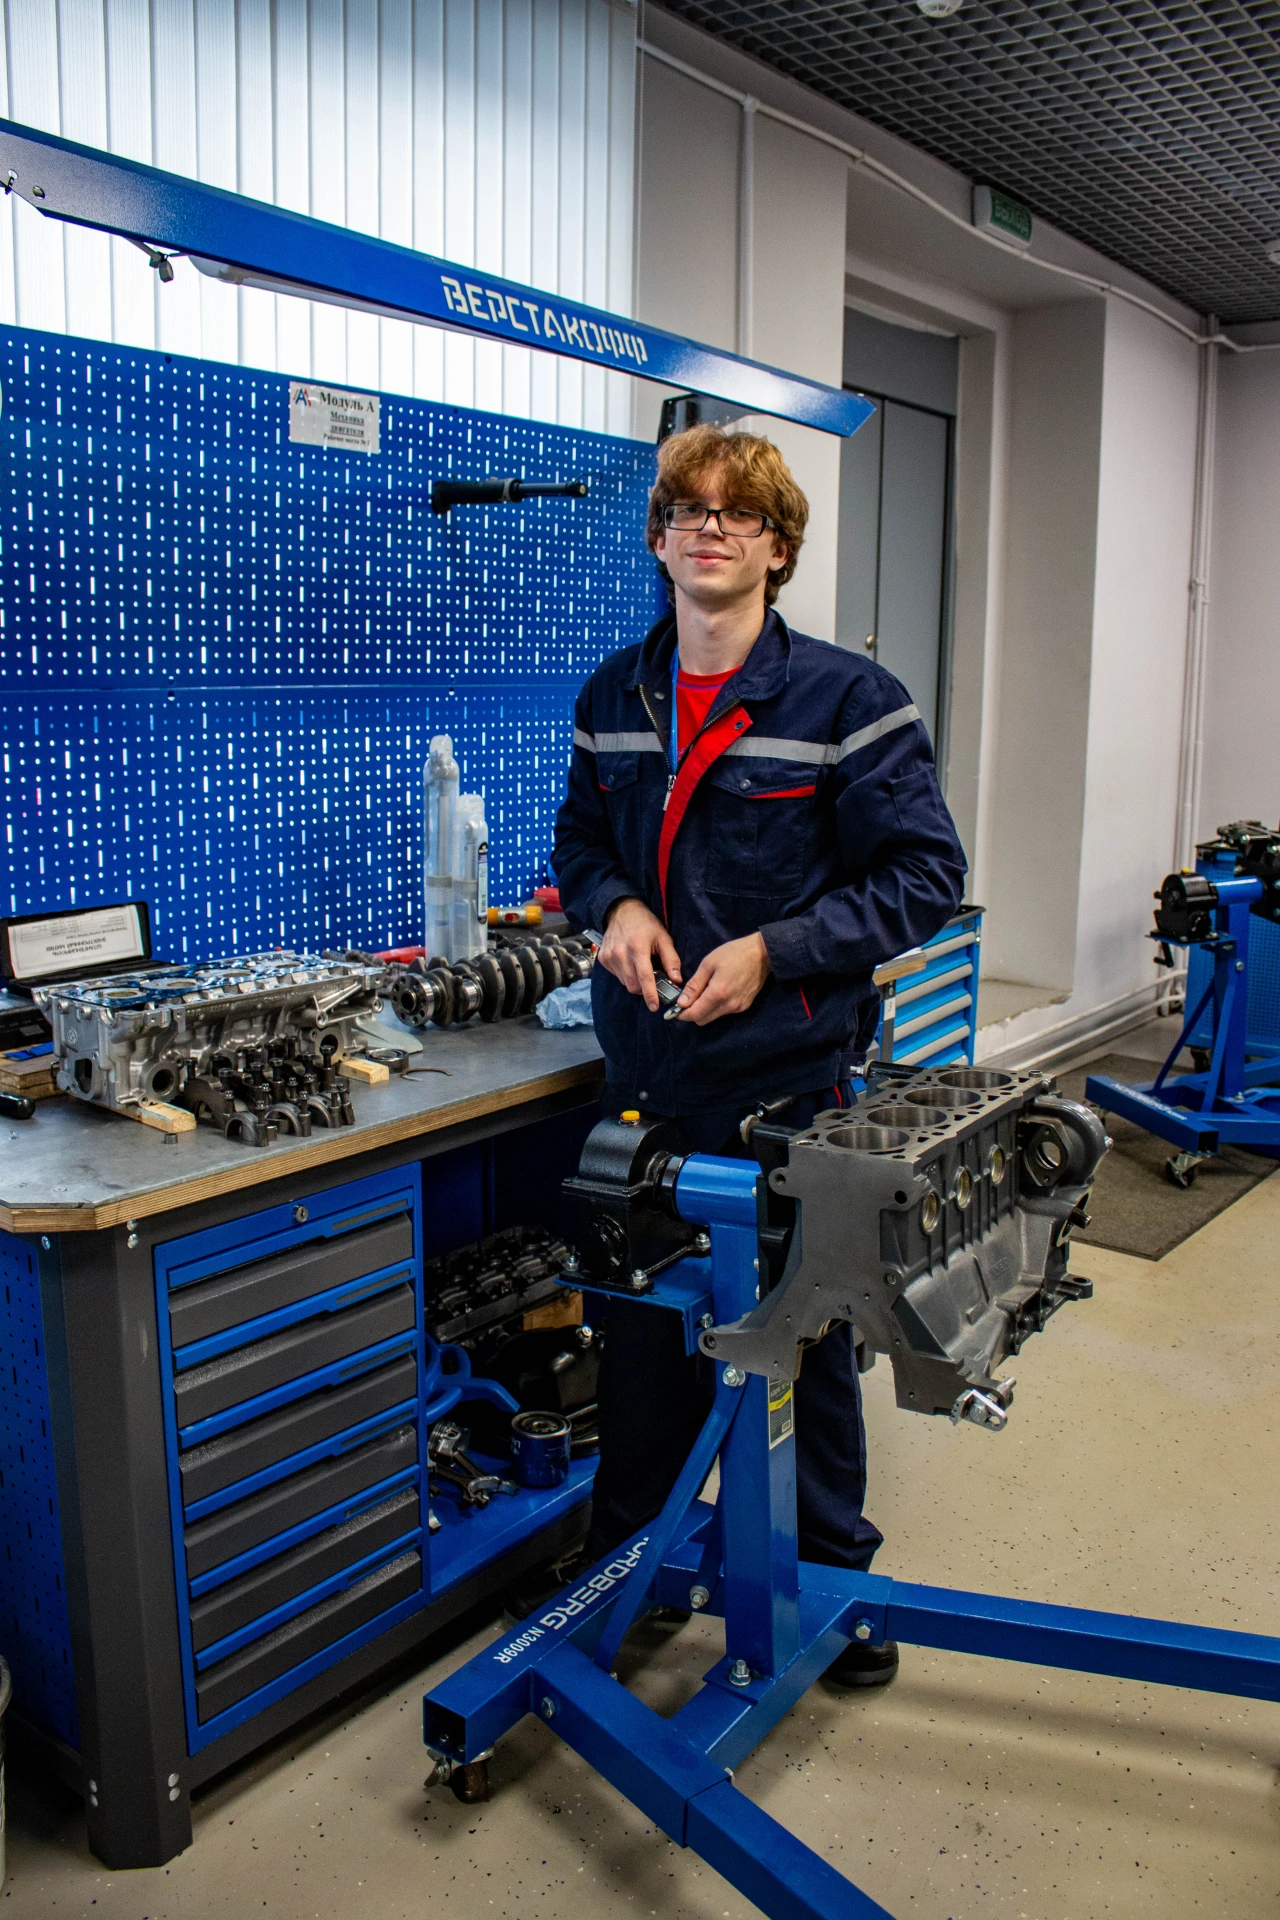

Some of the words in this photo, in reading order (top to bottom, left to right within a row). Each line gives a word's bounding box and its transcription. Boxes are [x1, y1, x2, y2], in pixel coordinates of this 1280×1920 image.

[440, 275, 648, 365] ВЕРСТАКОФФ
[320, 391, 364, 411] Модуль
[366, 401, 375, 413] А
[539, 1536, 649, 1630] ORDBERG
[493, 1626, 545, 1664] N3009R
